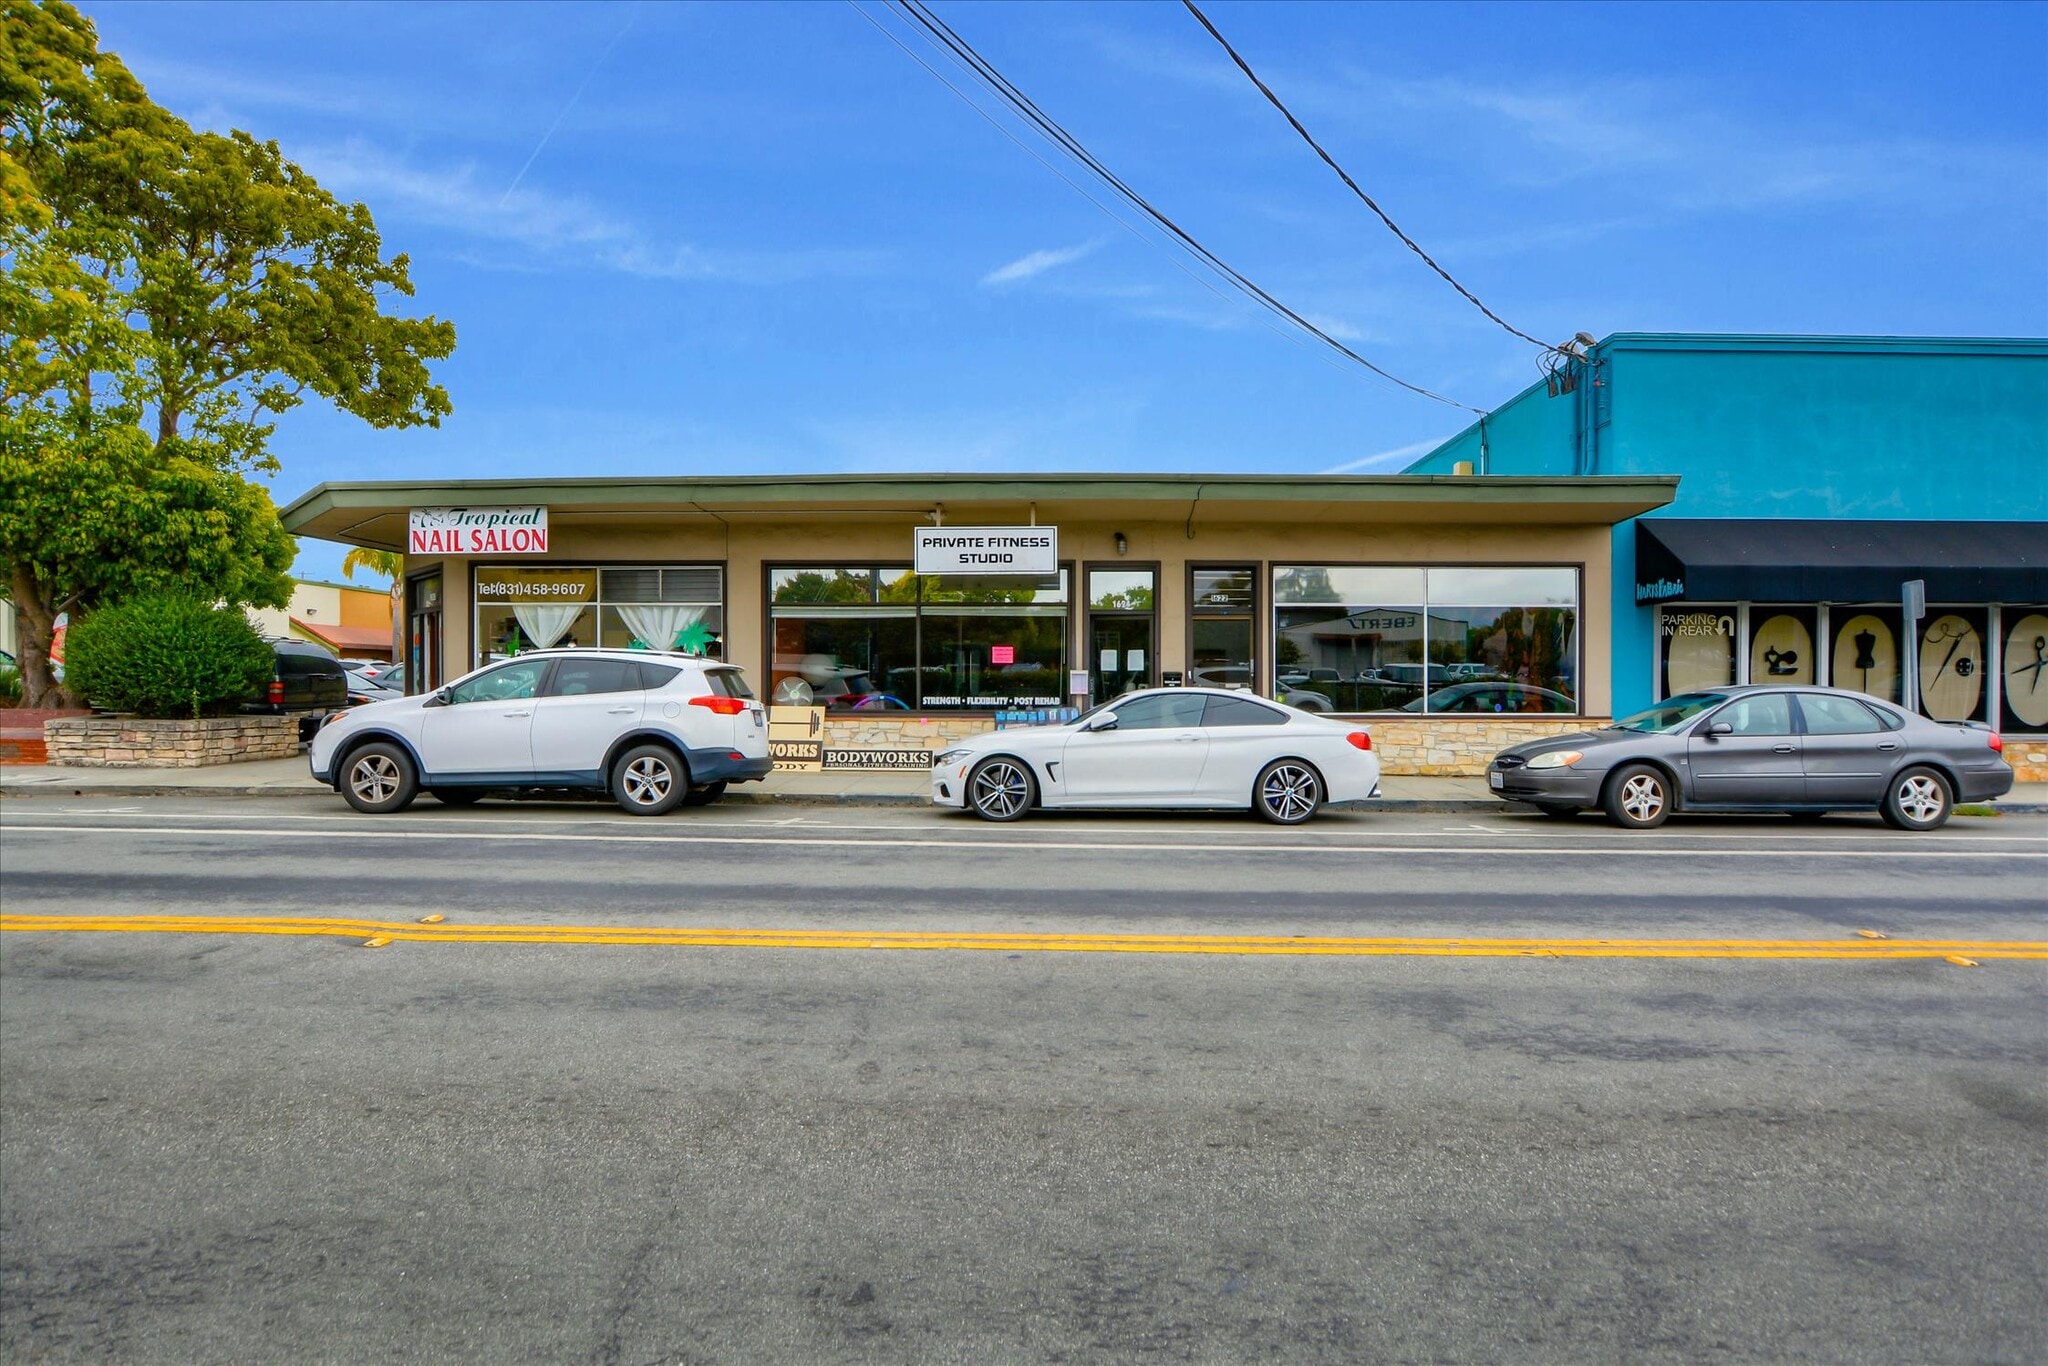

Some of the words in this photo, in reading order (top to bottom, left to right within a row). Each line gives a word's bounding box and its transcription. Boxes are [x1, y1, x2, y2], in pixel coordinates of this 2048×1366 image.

[448, 507, 541, 529] Tropical
[412, 530, 464, 552] NAIL
[471, 529, 546, 552] SALON
[922, 537, 984, 548] PRIVATE
[988, 537, 1050, 548] FITNESS
[959, 553, 1013, 564] STUDIO
[1661, 614, 1717, 625] PARKING
[1661, 625, 1674, 636] IN
[1679, 625, 1713, 636] REAR
[922, 696, 961, 705] STRENGTH
[966, 696, 1008, 705] FLEXIBILITY
[1014, 696, 1033, 705] POST
[1034, 696, 1061, 705] REHAB
[826, 751, 930, 763] BODYWORKS
